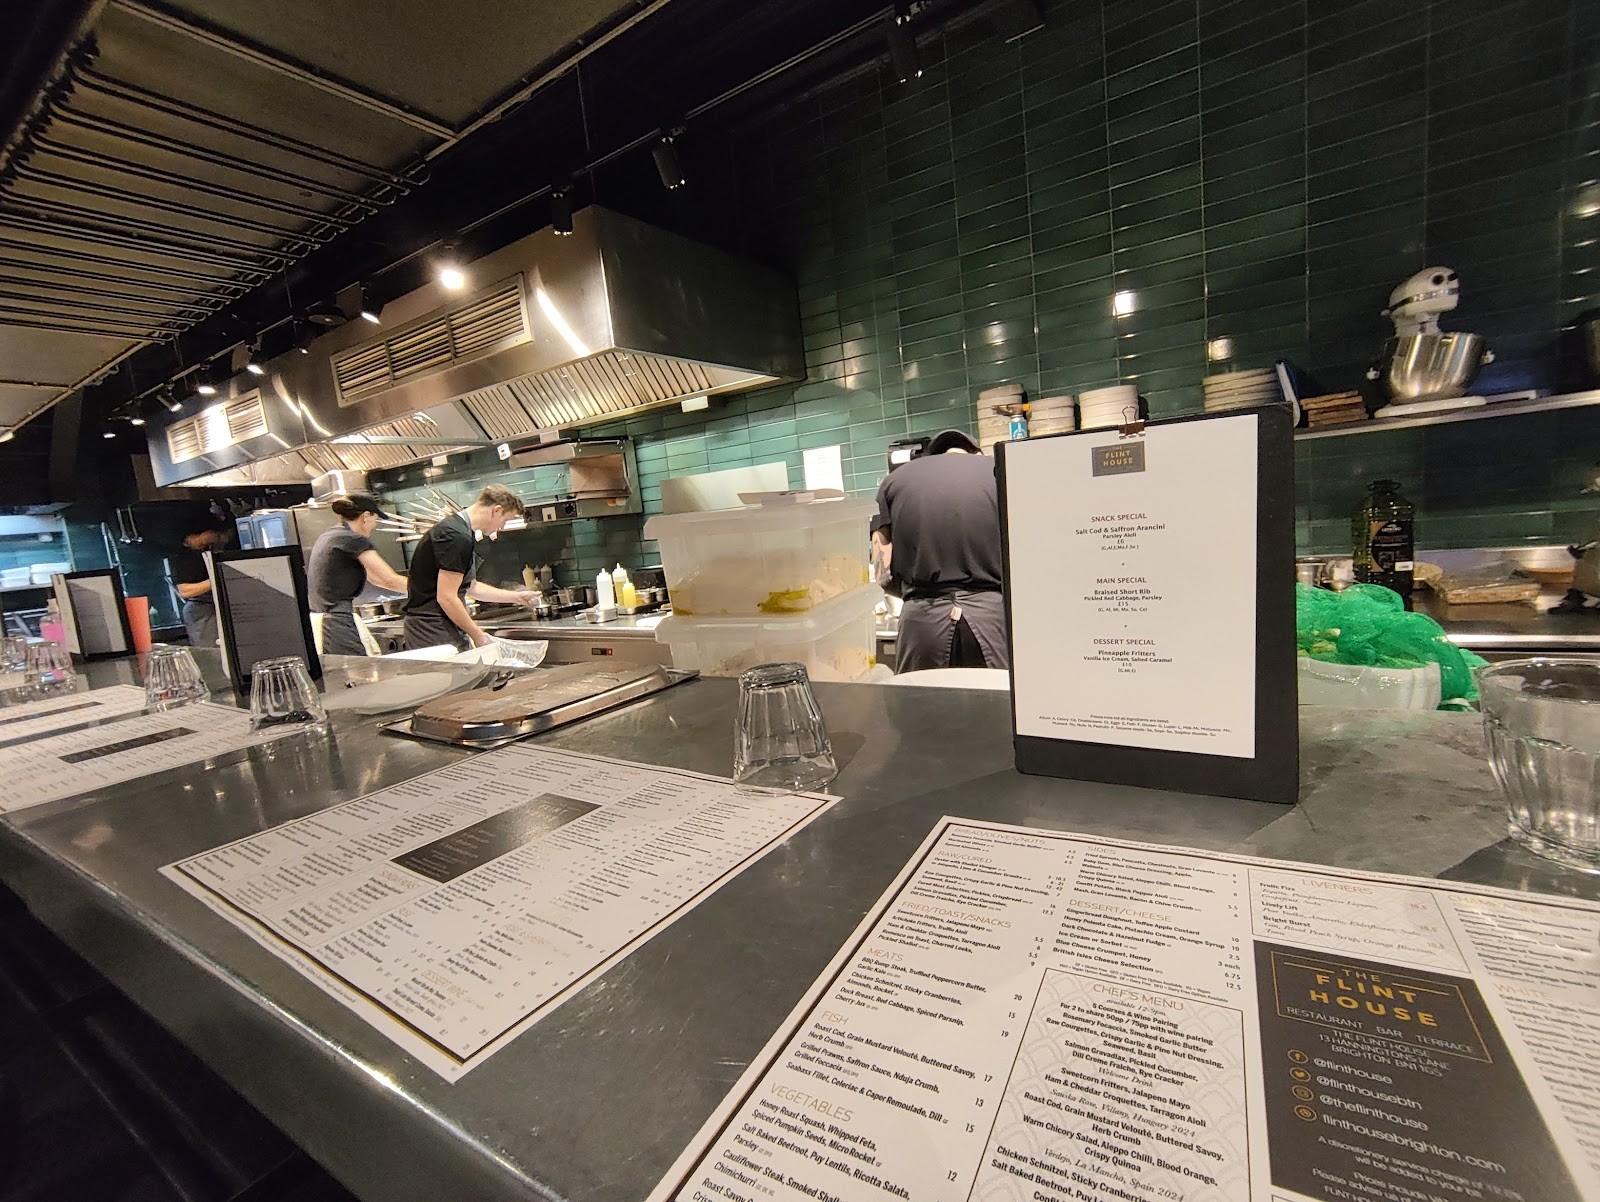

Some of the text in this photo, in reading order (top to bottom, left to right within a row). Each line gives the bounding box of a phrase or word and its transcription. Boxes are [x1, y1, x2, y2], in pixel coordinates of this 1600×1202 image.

[1103, 457, 1133, 467] HOUSE
[1105, 450, 1131, 459] FLINT
[1117, 513, 1147, 521] SPECIAL
[938, 851, 992, 863] RAW/CURED
[1302, 879, 1373, 894] LIVENERS
[901, 902, 1012, 928] FRIED/TOAST/SNACKS
[1069, 899, 1172, 922] DESSERT/CHEESE
[1263, 916, 1310, 927] Bright Burst
[867, 948, 903, 962] MEATS
[1225, 972, 1240, 980] 6.75
[1226, 982, 1241, 990] 12.5
[1316, 973, 1417, 1003] FLINT
[1343, 969, 1381, 982] THE
[1093, 984, 1183, 1011] CHEF'S MENU
[1493, 984, 1549, 1000] WHITE
[821, 1011, 849, 1025] FISH
[1098, 1004, 1125, 1015] Courses
[1134, 1013, 1151, 1022] Wine
[1153, 1017, 1178, 1029] Pairing
[1310, 990, 1438, 1026] HOUSE
[1001, 1030, 1009, 1038] 19
[1063, 1013, 1207, 1053] Rosemary Focaccia, Smoked Garlic Butter
[1086, 1009, 1105, 1018] share
[1106, 1014, 1123, 1024] 50pp
[1131, 1019, 1148, 1030] 75pp
[1150, 1024, 1166, 1032] with
[1168, 1028, 1185, 1037] wine
[1186, 1033, 1213, 1045] pairing
[1286, 1006, 1473, 1053] RESTAURANT BAR TERRACE
[1046, 1018, 1059, 1026] Raw
[1061, 1021, 1099, 1037] Courgettes,
[1101, 1032, 1122, 1043] Crispy
[1124, 1037, 1145, 1047] Garlic
[1155, 1044, 1170, 1054] Pine
[1172, 1049, 1185, 1058] Nut
[1187, 1053, 1224, 1069] Dressing,
[1103, 1040, 1155, 1058] Seaweed, Basil
[1333, 1030, 1431, 1057] THE FLINT HOUSE
[801, 1042, 939, 1094] Grilled Prawns, Saffron Sauce, Nduja Crumb,
[984, 1074, 992, 1082] 17
[1314, 1057, 1393, 1084] @flinthouse
[1045, 1074, 1061, 1084] Ham
[1070, 1082, 1101, 1096] Cheddar
[1103, 1092, 1148, 1111] Croquettes,
[1150, 1105, 1185, 1120] Tarragon
[1187, 1116, 1206, 1127] Aioli
[1061, 1067, 1191, 1110] Sweetcorn Fritters, Jalapeno Mayo
[1317, 1076, 1422, 1110] @flinthousebtn
[771, 1083, 853, 1123] VEGETABLES
[975, 1098, 984, 1107] 13
[1320, 1095, 1428, 1131] @theflinthouse
[752, 1109, 876, 1165] Spiced Pumpkin Seeds, Micro Rocket
[759, 1098, 876, 1152] Honey Roast Squash, Whipped Feta,
[966, 1123, 975, 1133] 15
[1024, 1092, 1224, 1161] Roast Cod, Grain Mustard Velouté, Buttered Savoy,
[1092, 1124, 1141, 1146] Herb Crumb
[1023, 1114, 1218, 1186] Warm Chicory Salad, Aleppo Chilli, Blood Orange,
[1323, 1114, 1506, 1174] flinthousebrighton.com
[1085, 1147, 1141, 1173] Crispy Quinoa
[947, 1171, 957, 1182] 12
